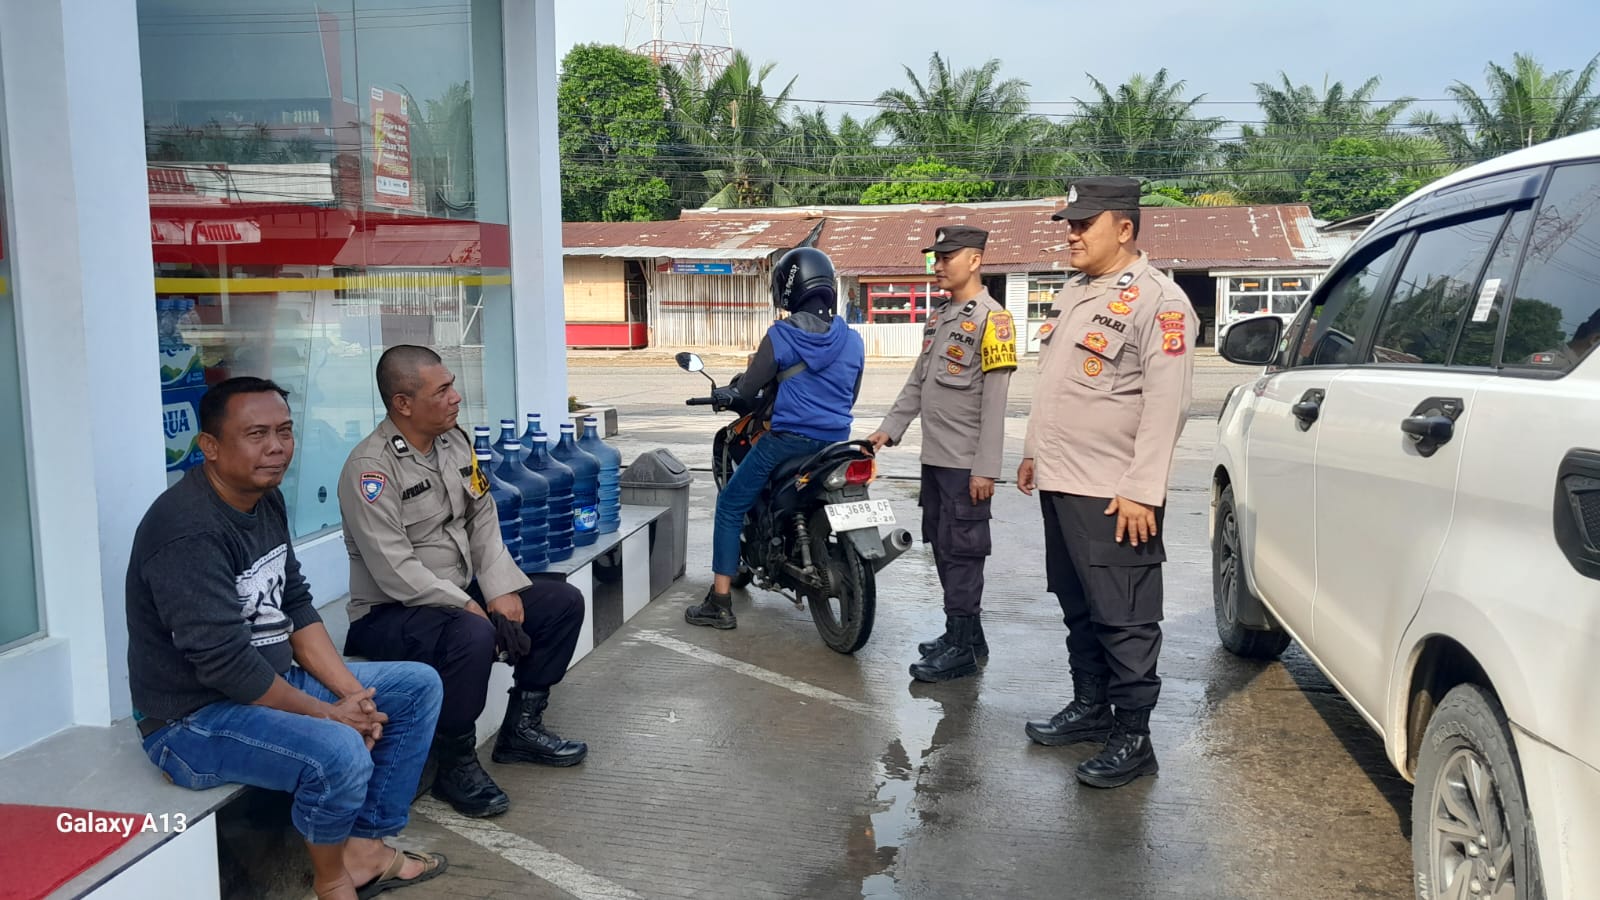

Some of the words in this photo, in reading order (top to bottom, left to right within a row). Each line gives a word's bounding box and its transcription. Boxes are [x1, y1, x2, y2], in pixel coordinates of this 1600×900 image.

[1091, 314, 1127, 333] POLRI
[949, 331, 975, 346] POLRI
[828, 505, 842, 517] BL
[876, 501, 889, 512] CF
